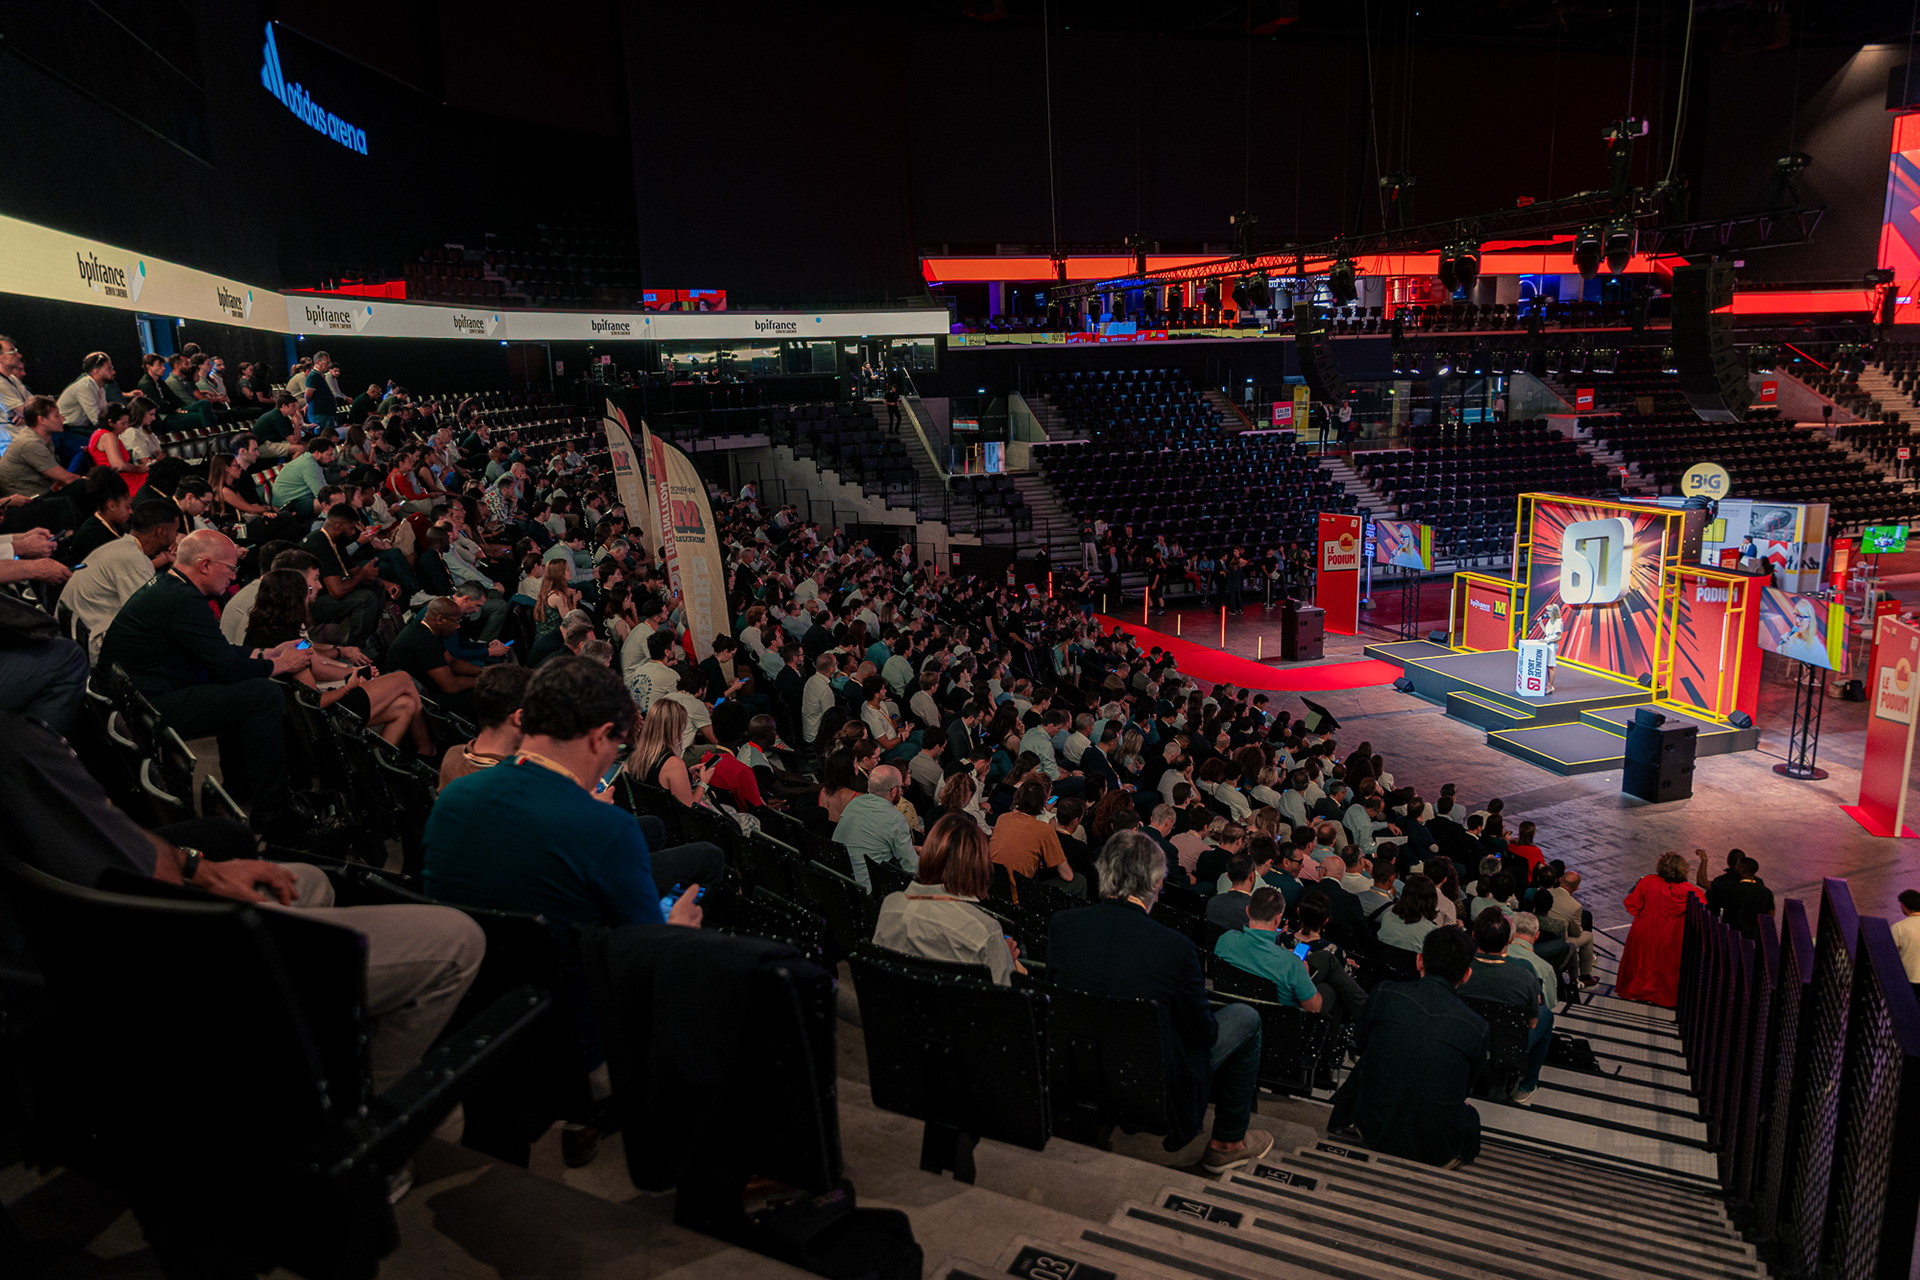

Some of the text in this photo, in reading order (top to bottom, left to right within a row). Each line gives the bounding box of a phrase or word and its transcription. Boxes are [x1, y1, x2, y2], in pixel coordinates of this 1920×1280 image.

[286, 82, 368, 156] adidas arena
[76, 251, 127, 288] bpifrance
[216, 286, 243, 313] bpifrance
[305, 305, 351, 325] bpifrance
[453, 314, 485, 330] bpifrance
[591, 319, 630, 333] bpifrance
[754, 319, 797, 332] bpifrance
[1327, 546, 1335, 554] LE
[1327, 553, 1356, 565] PODIUM
[1527, 658, 1535, 676] SPORT
[1882, 676, 1890, 690] LE
[1880, 691, 1910, 714] PODIUM
